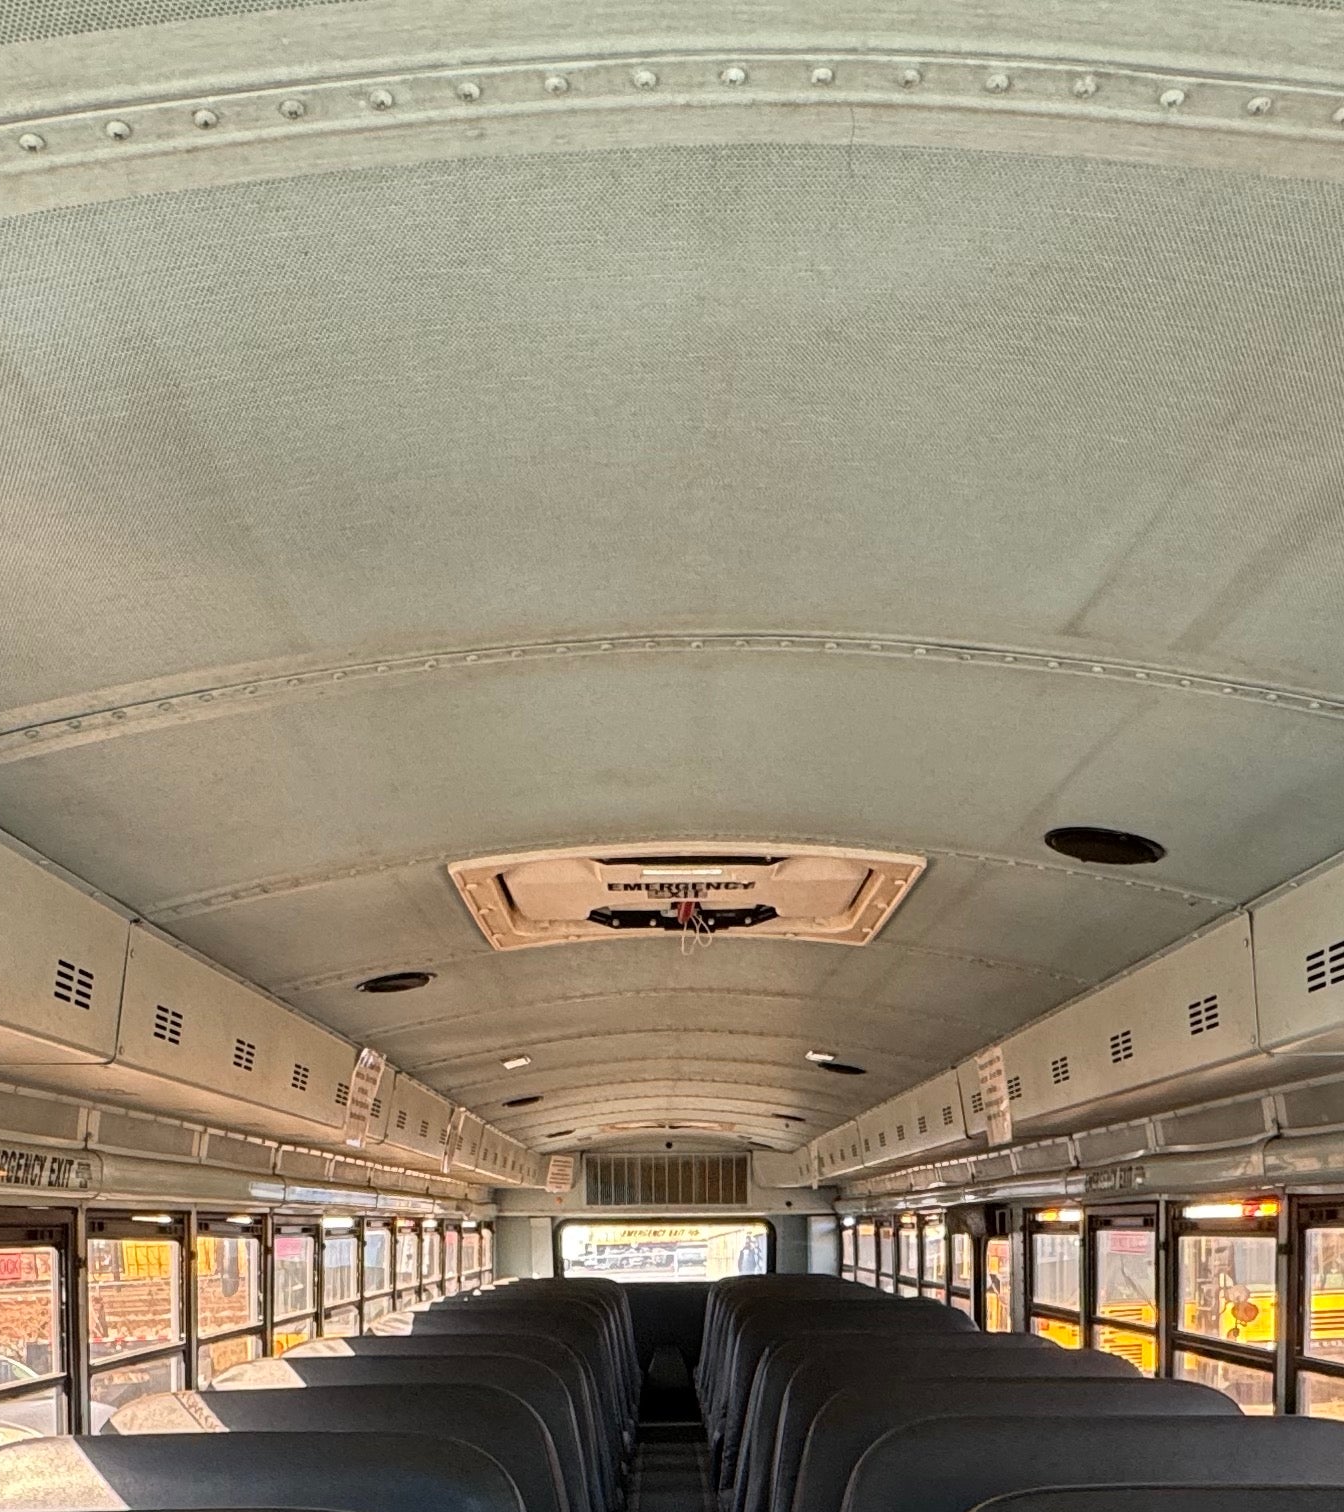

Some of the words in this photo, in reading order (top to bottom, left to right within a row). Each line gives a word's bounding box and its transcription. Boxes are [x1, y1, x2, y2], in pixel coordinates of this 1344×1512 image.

[607, 881, 757, 892] EMERGENCY
[655, 889, 701, 899] EXIT
[47, 1156, 75, 1189] EXIT
